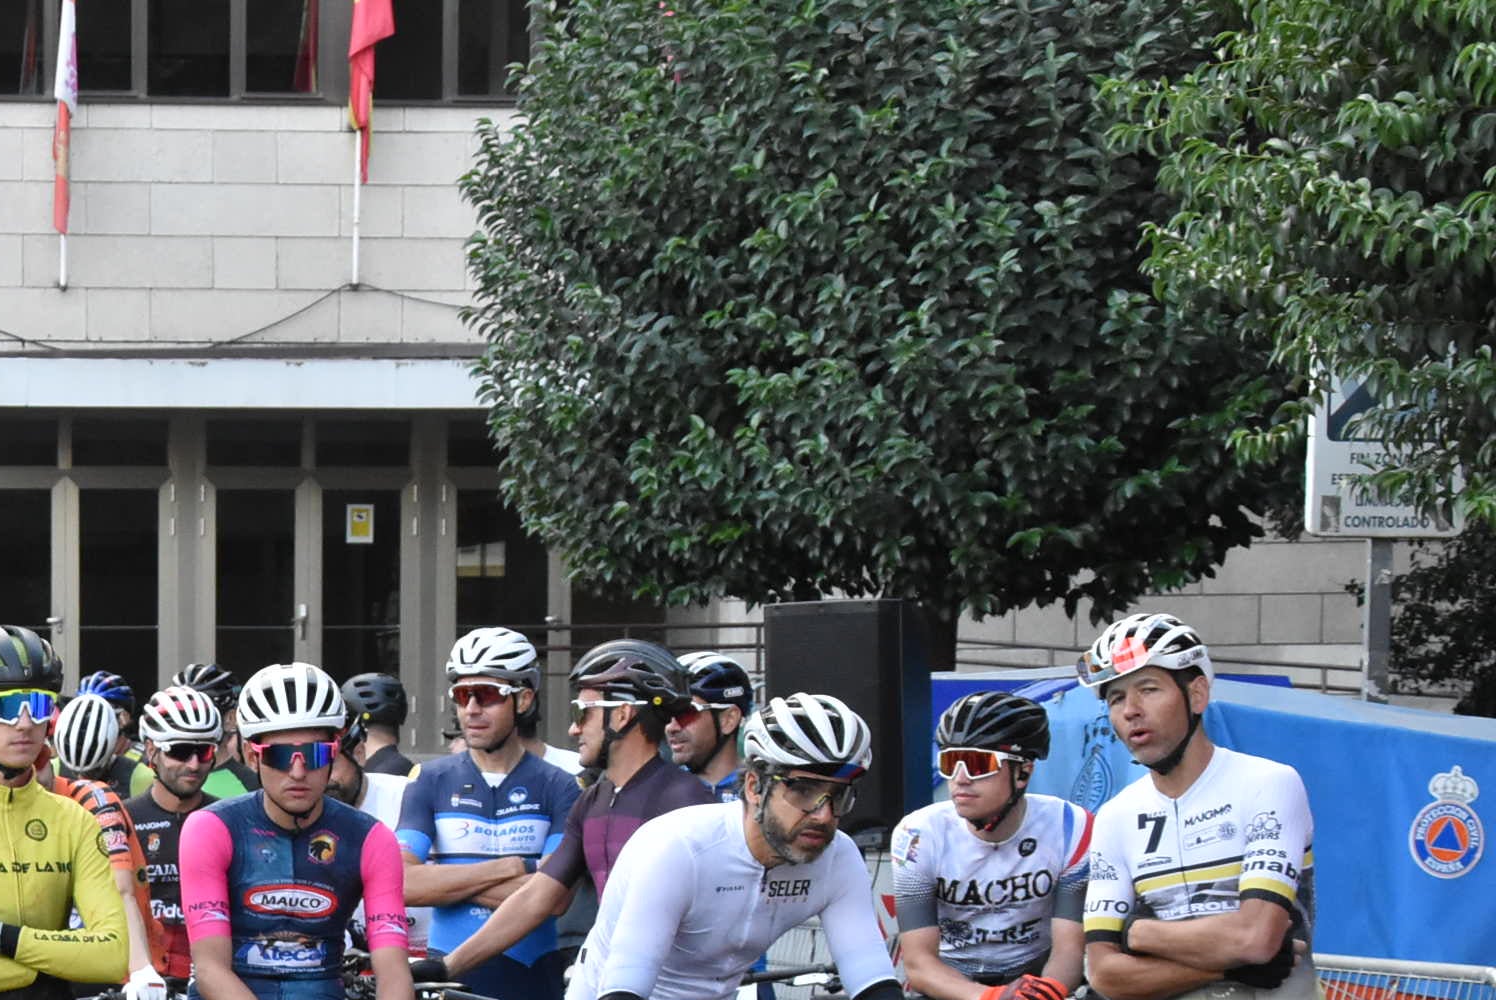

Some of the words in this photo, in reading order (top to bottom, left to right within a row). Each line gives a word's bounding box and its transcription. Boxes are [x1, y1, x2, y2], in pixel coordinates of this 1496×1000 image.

[1344, 516, 1430, 529] CONTROLADO
[1137, 813, 1168, 855] 7
[35, 861, 54, 873] LA
[146, 864, 179, 876] CAJA
[767, 879, 811, 898] SELER
[935, 868, 1054, 907] MACHO
[261, 893, 321, 911] MAUCO
